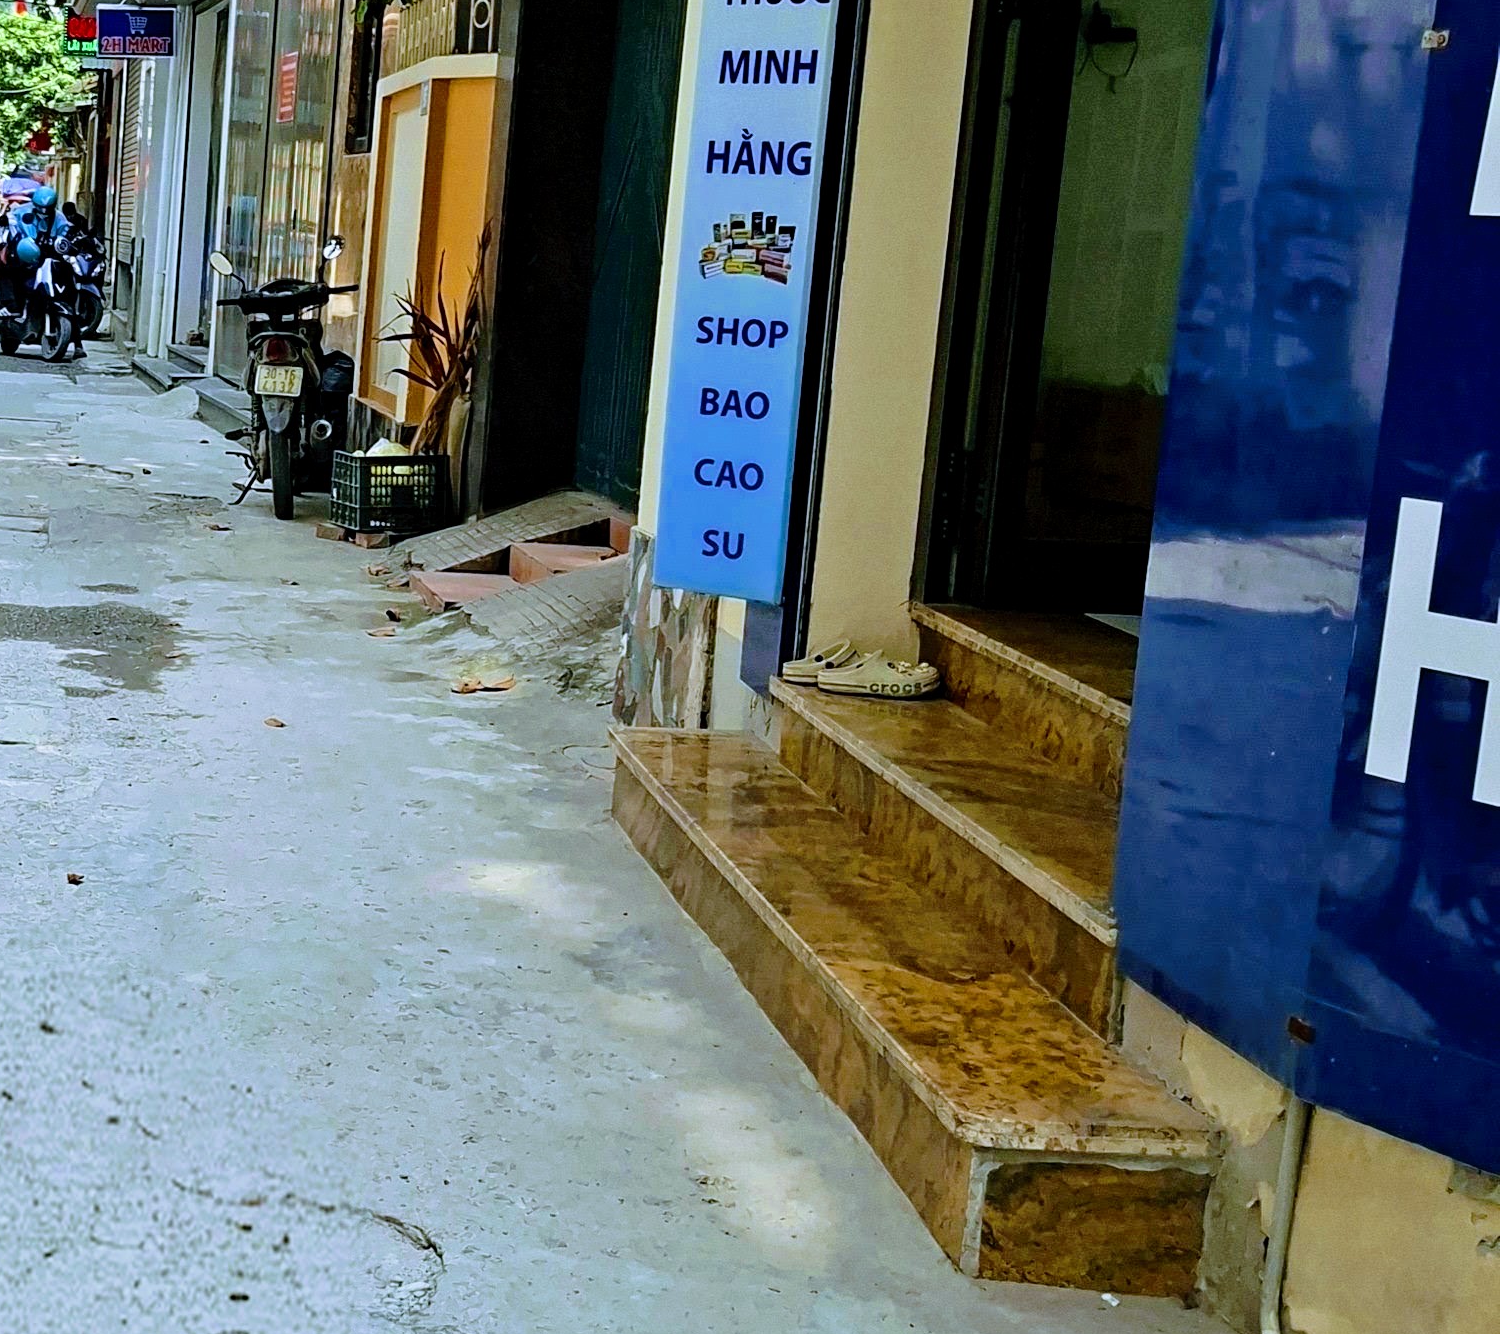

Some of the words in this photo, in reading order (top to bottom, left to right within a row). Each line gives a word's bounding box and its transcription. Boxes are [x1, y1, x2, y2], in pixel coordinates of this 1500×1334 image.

[101, 35, 123, 54] 2H
[125, 36, 171, 54] MART
[718, 49, 819, 85] MINH
[705, 128, 813, 177] HẰNG
[695, 316, 789, 349] SHOP
[699, 387, 771, 420] BAO
[693, 458, 765, 491] CAO
[701, 529, 746, 561] SU
